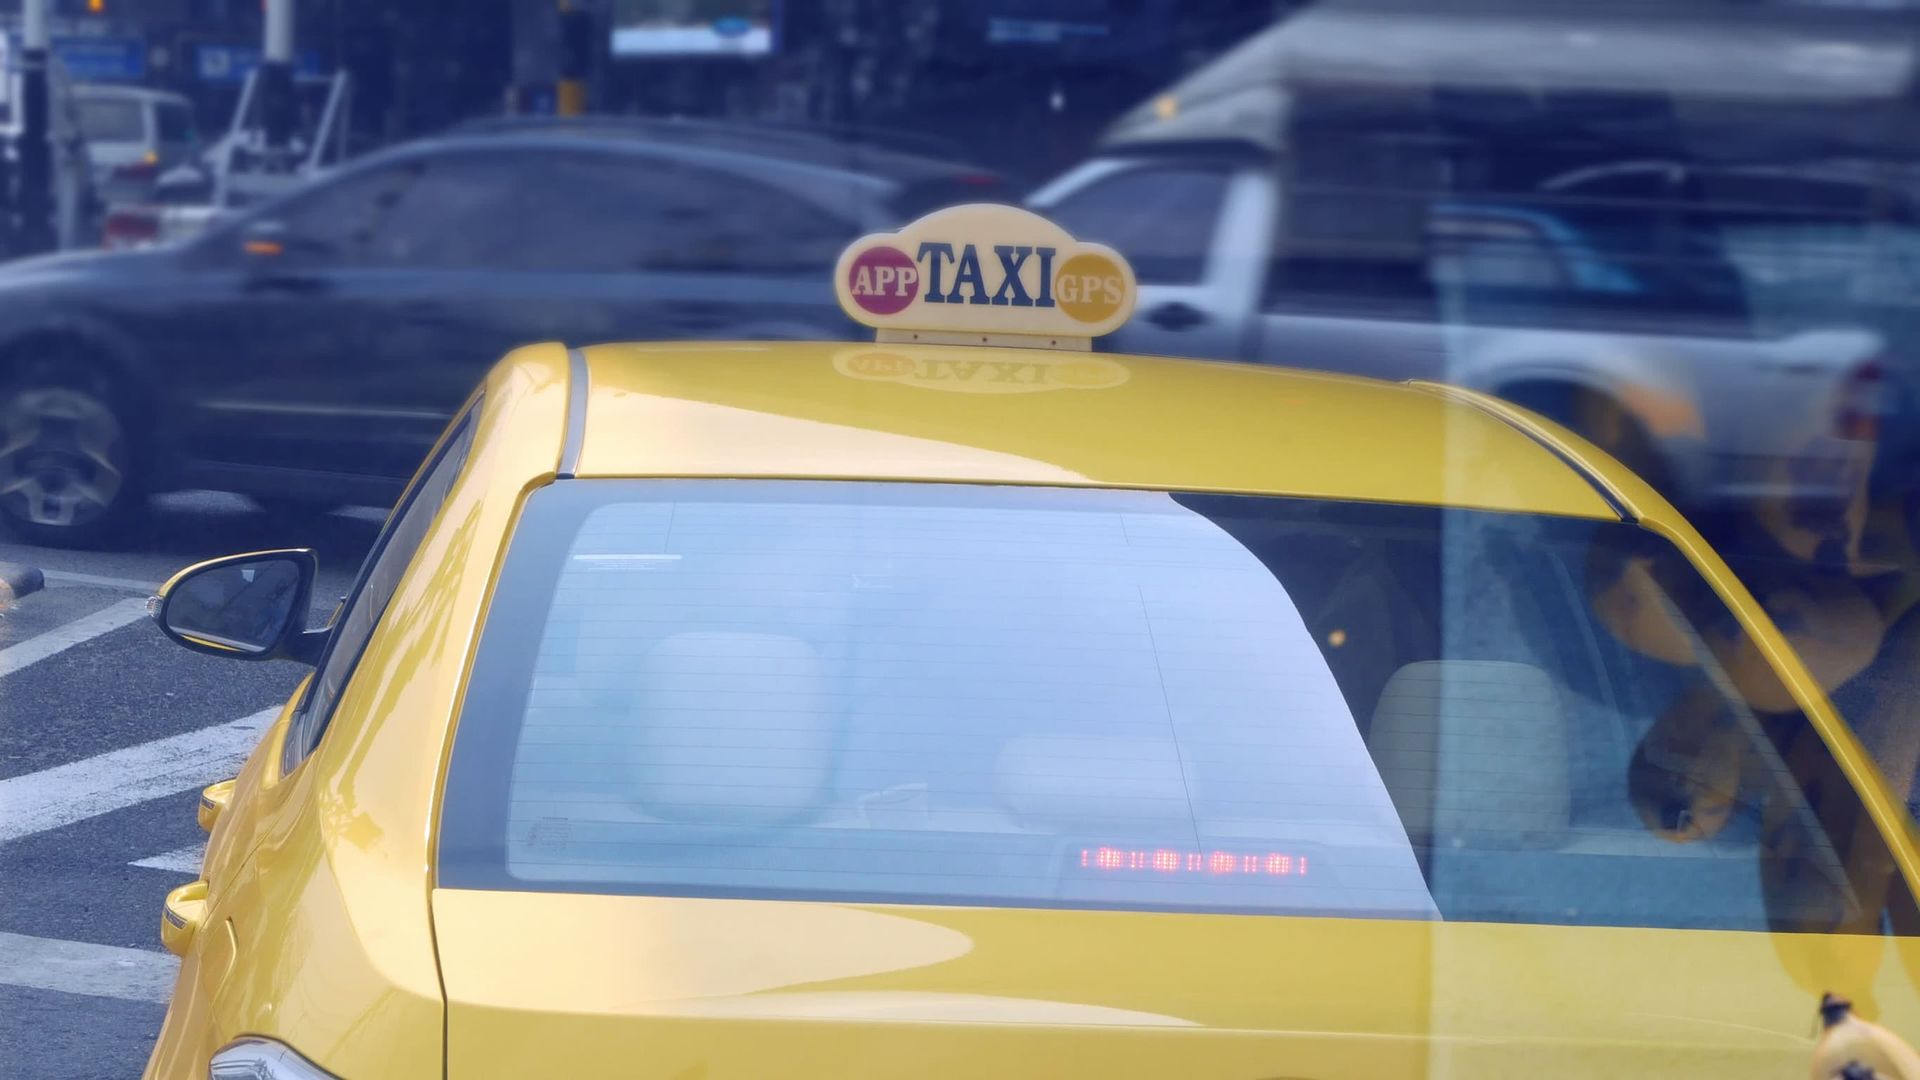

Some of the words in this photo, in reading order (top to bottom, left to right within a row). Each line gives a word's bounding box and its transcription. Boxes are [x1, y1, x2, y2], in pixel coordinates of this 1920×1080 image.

[852, 265, 917, 297] APP
[917, 241, 1056, 308] TAXI
[1057, 274, 1122, 305] GPS
